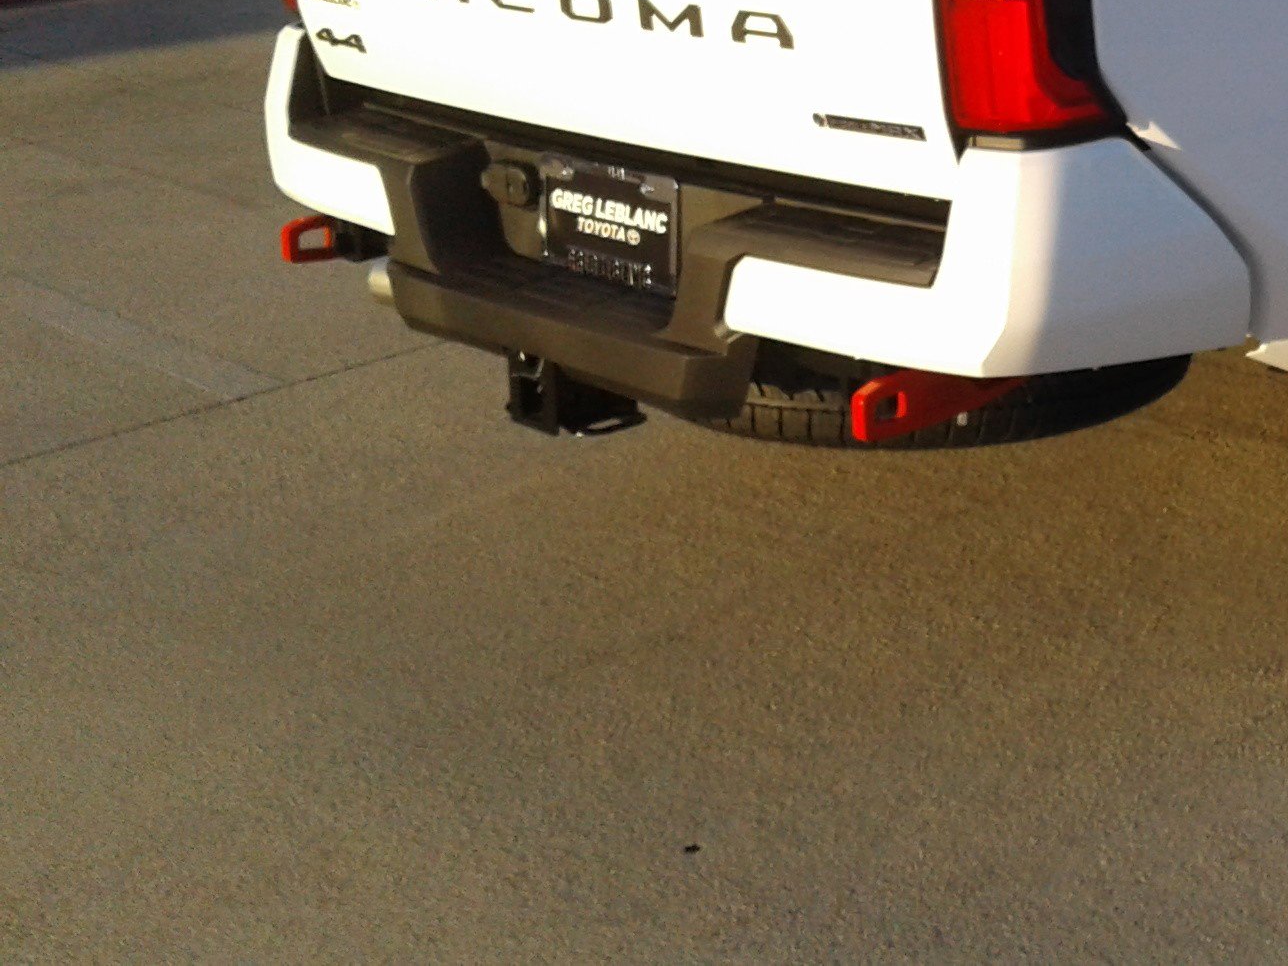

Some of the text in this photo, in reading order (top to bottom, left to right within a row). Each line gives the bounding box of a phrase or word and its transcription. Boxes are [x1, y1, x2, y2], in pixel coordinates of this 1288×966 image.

[550, 188, 669, 234] GREG LEBLANC
[577, 216, 625, 242] TOYOTA
